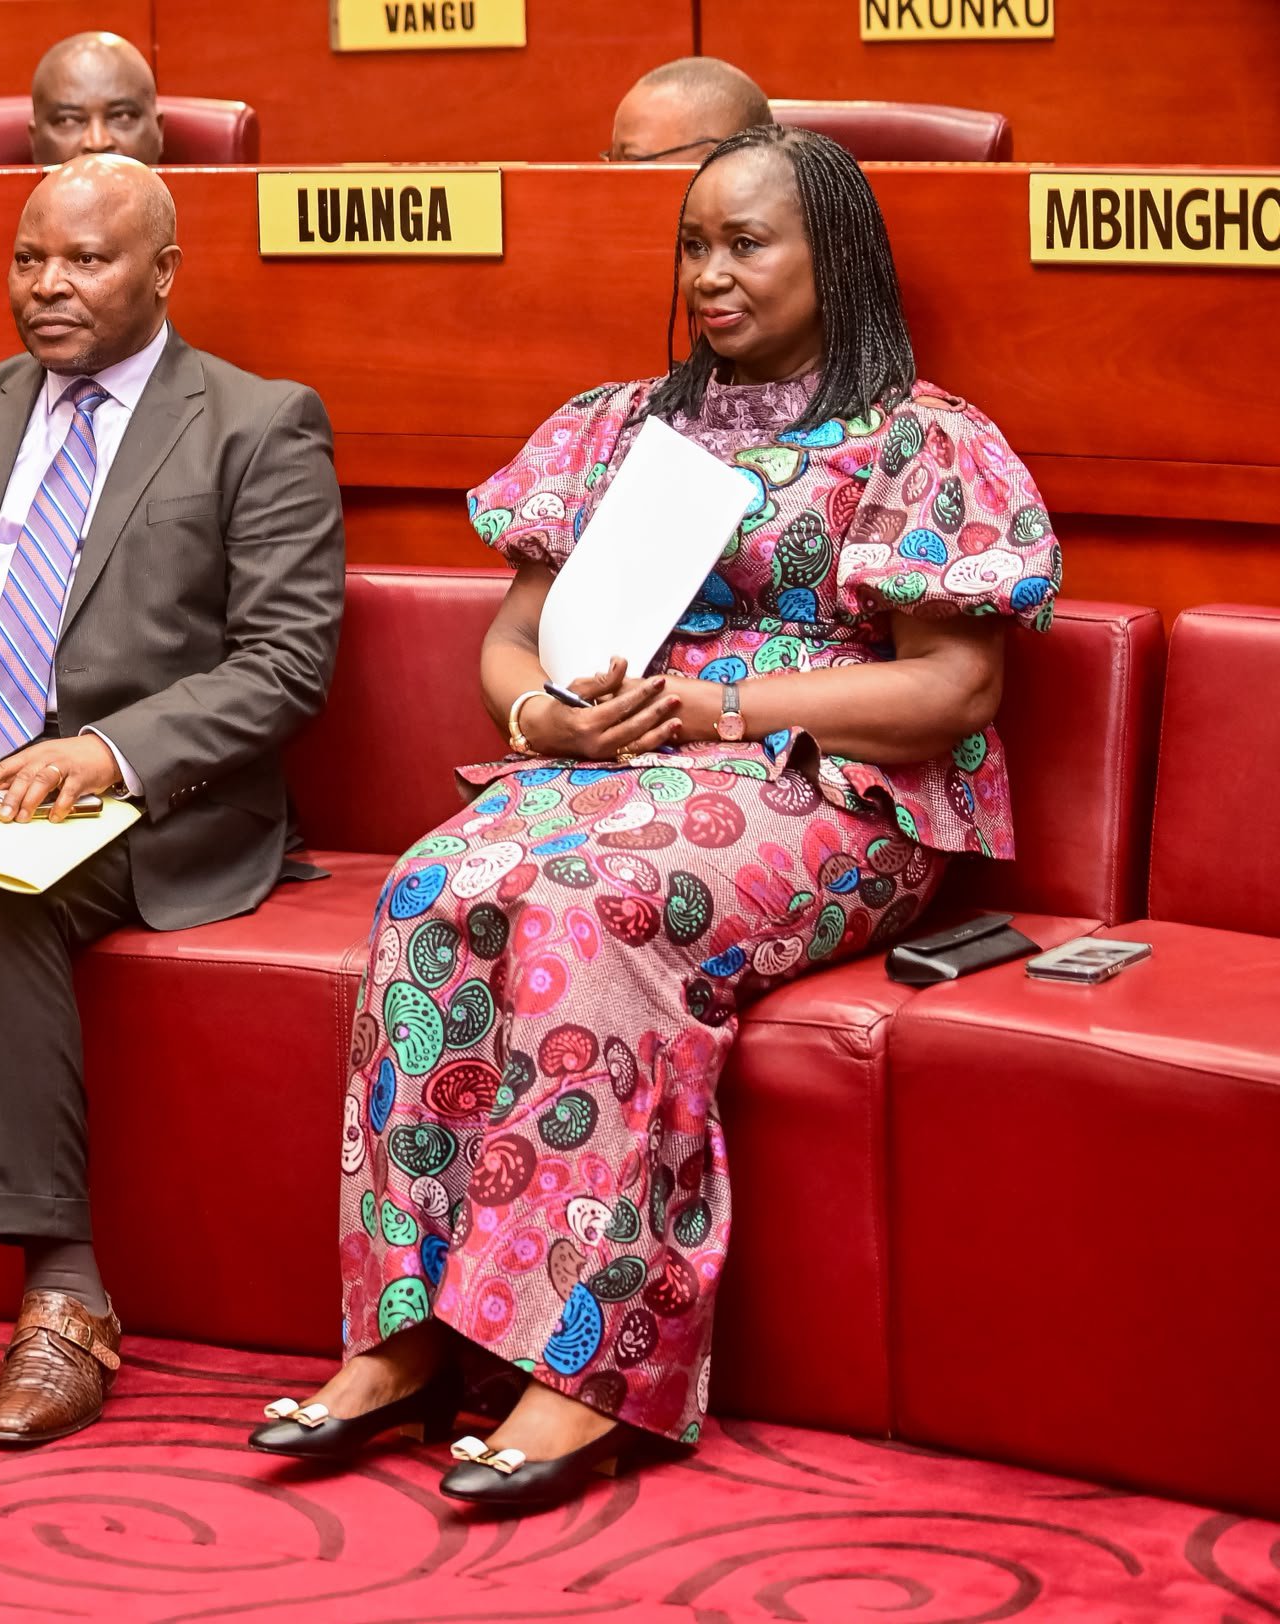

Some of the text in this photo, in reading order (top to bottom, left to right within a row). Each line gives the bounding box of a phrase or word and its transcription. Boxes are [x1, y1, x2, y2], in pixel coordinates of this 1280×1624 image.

[385, 1, 475, 32] VANGU
[866, 0, 1049, 29] NKUNKU
[298, 186, 452, 243] LUANGA
[1046, 187, 1280, 251] MBINGHO
